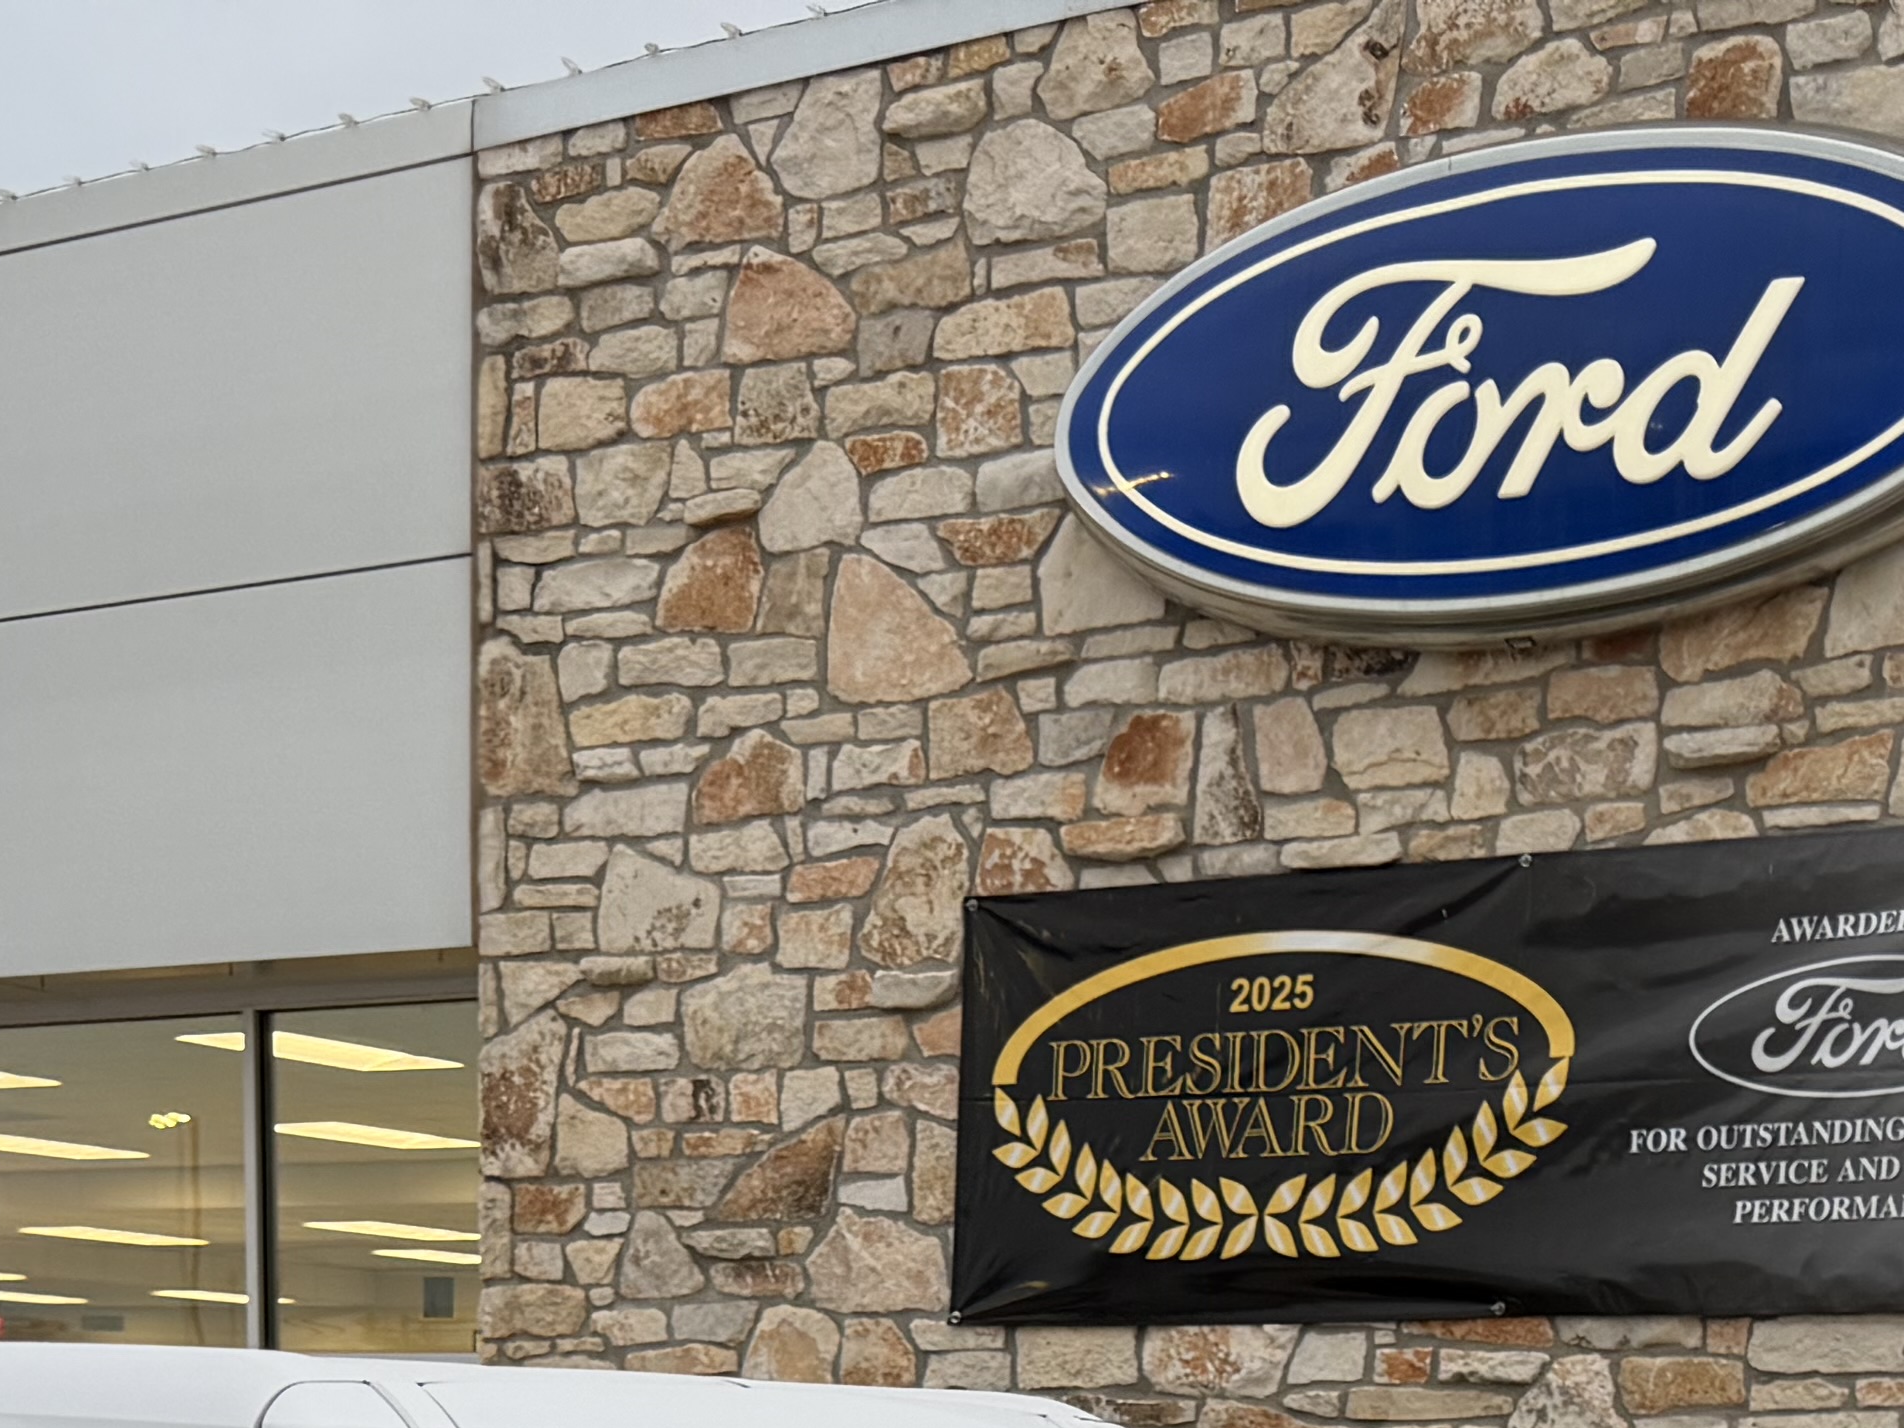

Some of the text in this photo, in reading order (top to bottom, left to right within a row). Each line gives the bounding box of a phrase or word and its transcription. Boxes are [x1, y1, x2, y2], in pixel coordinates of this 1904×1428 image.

[1235, 236, 1805, 528] Ford
[1228, 974, 1315, 1014] 2025
[1046, 1014, 1520, 1102] PRESIDENT'S
[1138, 1090, 1395, 1163] AWARD
[1628, 1128, 1689, 1154] FOR
[1701, 1157, 1829, 1188] SERVICE
[1836, 1155, 1901, 1183] AND
